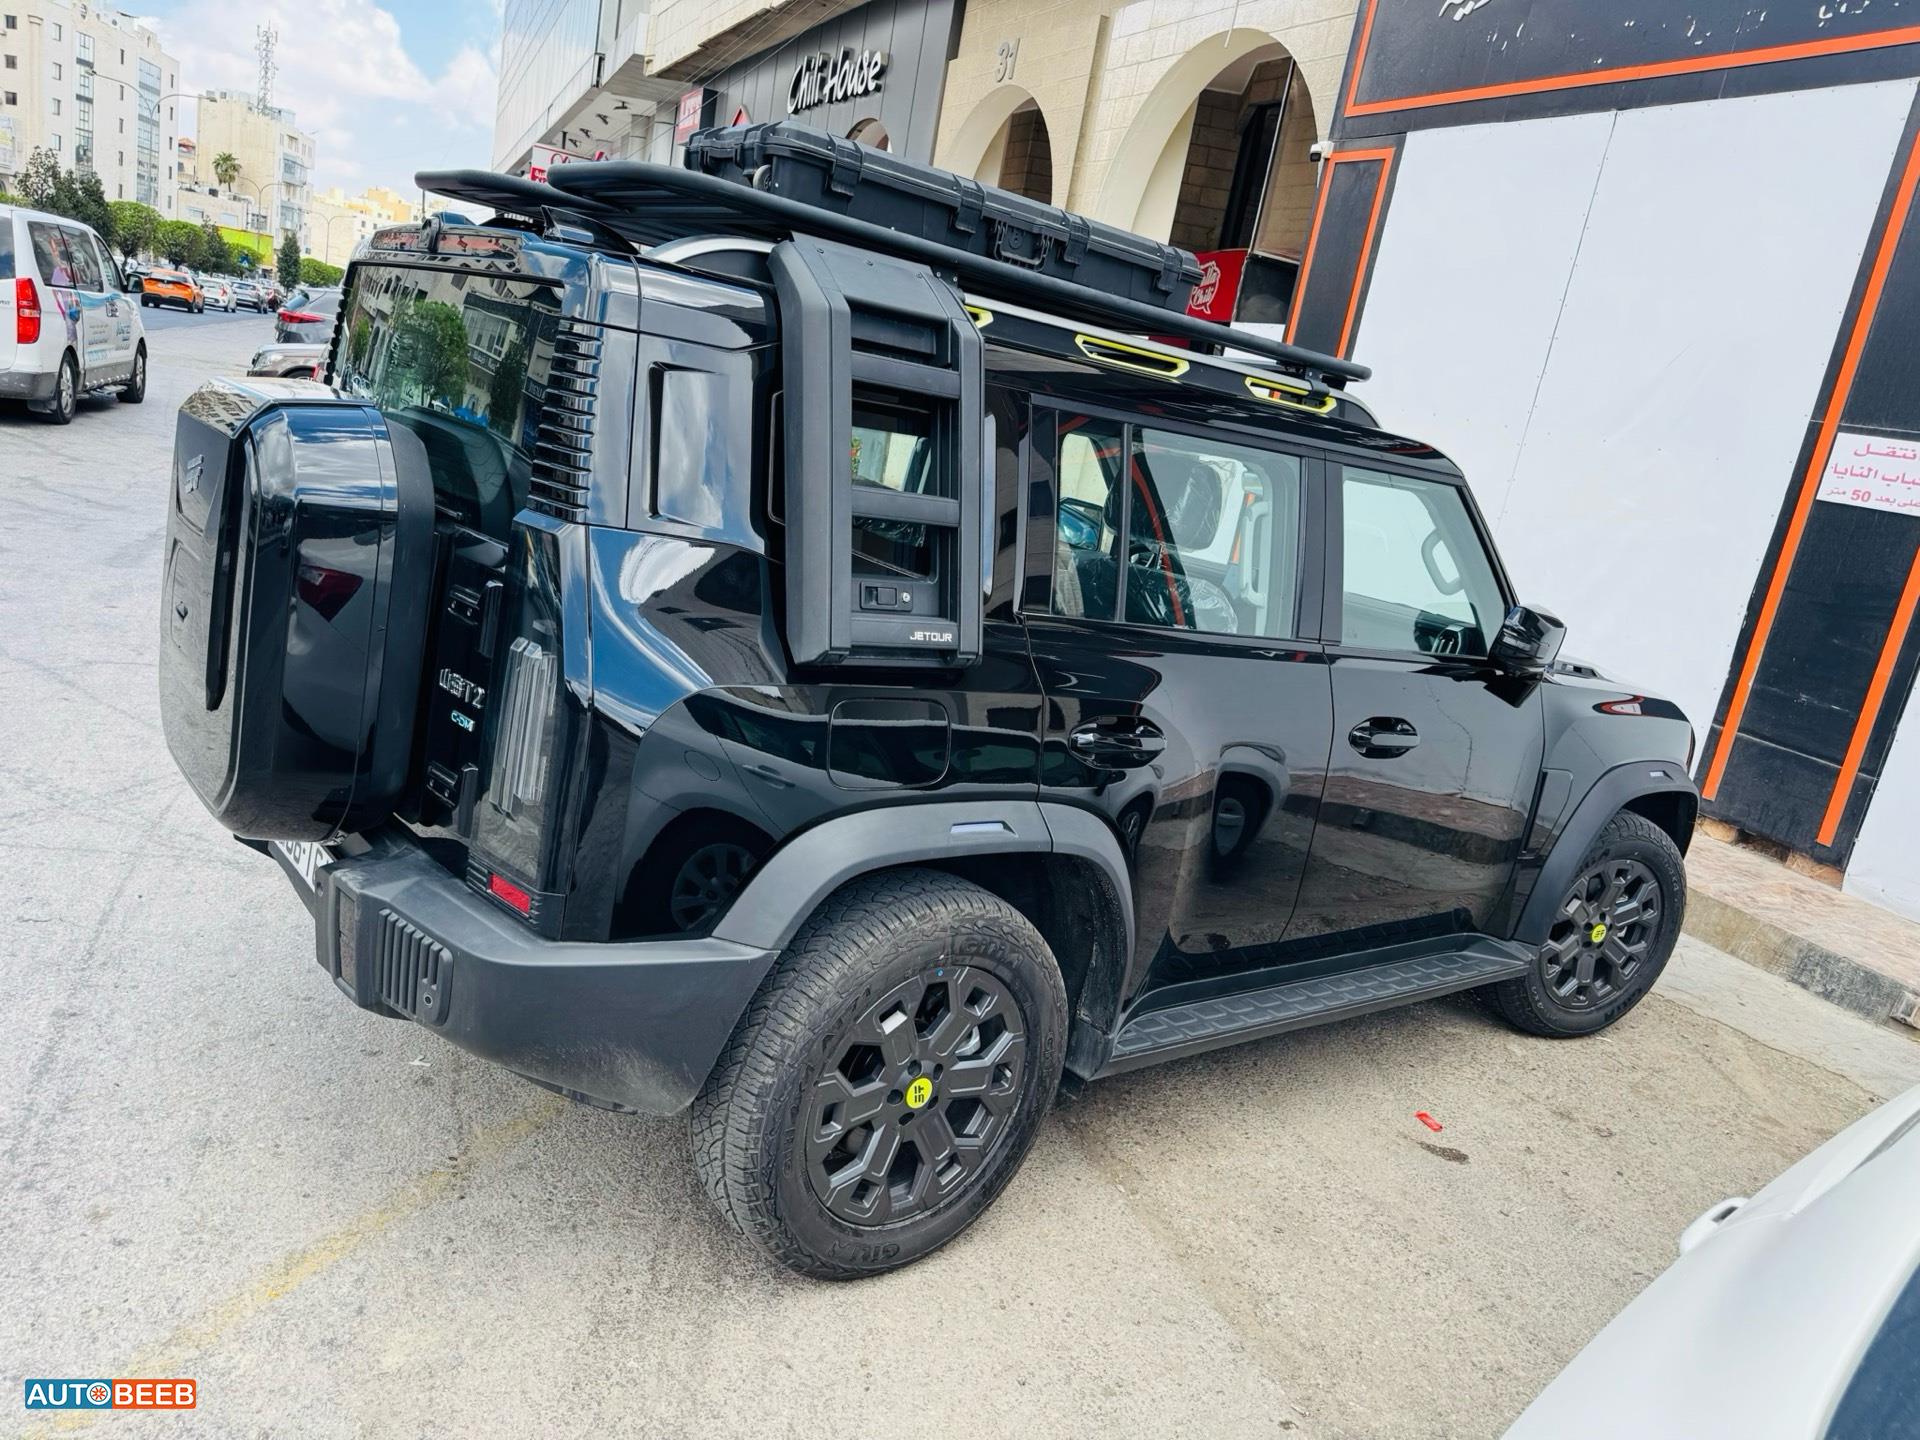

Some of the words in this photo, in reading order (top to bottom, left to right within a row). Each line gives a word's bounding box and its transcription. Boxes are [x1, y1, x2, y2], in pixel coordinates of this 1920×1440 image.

[995, 37, 1020, 83] 31
[787, 51, 823, 114] Chili
[823, 46, 882, 104] House
[1853, 443, 1920, 461] نتقل
[1850, 489, 1872, 503] 50
[909, 631, 953, 642] JETOUR
